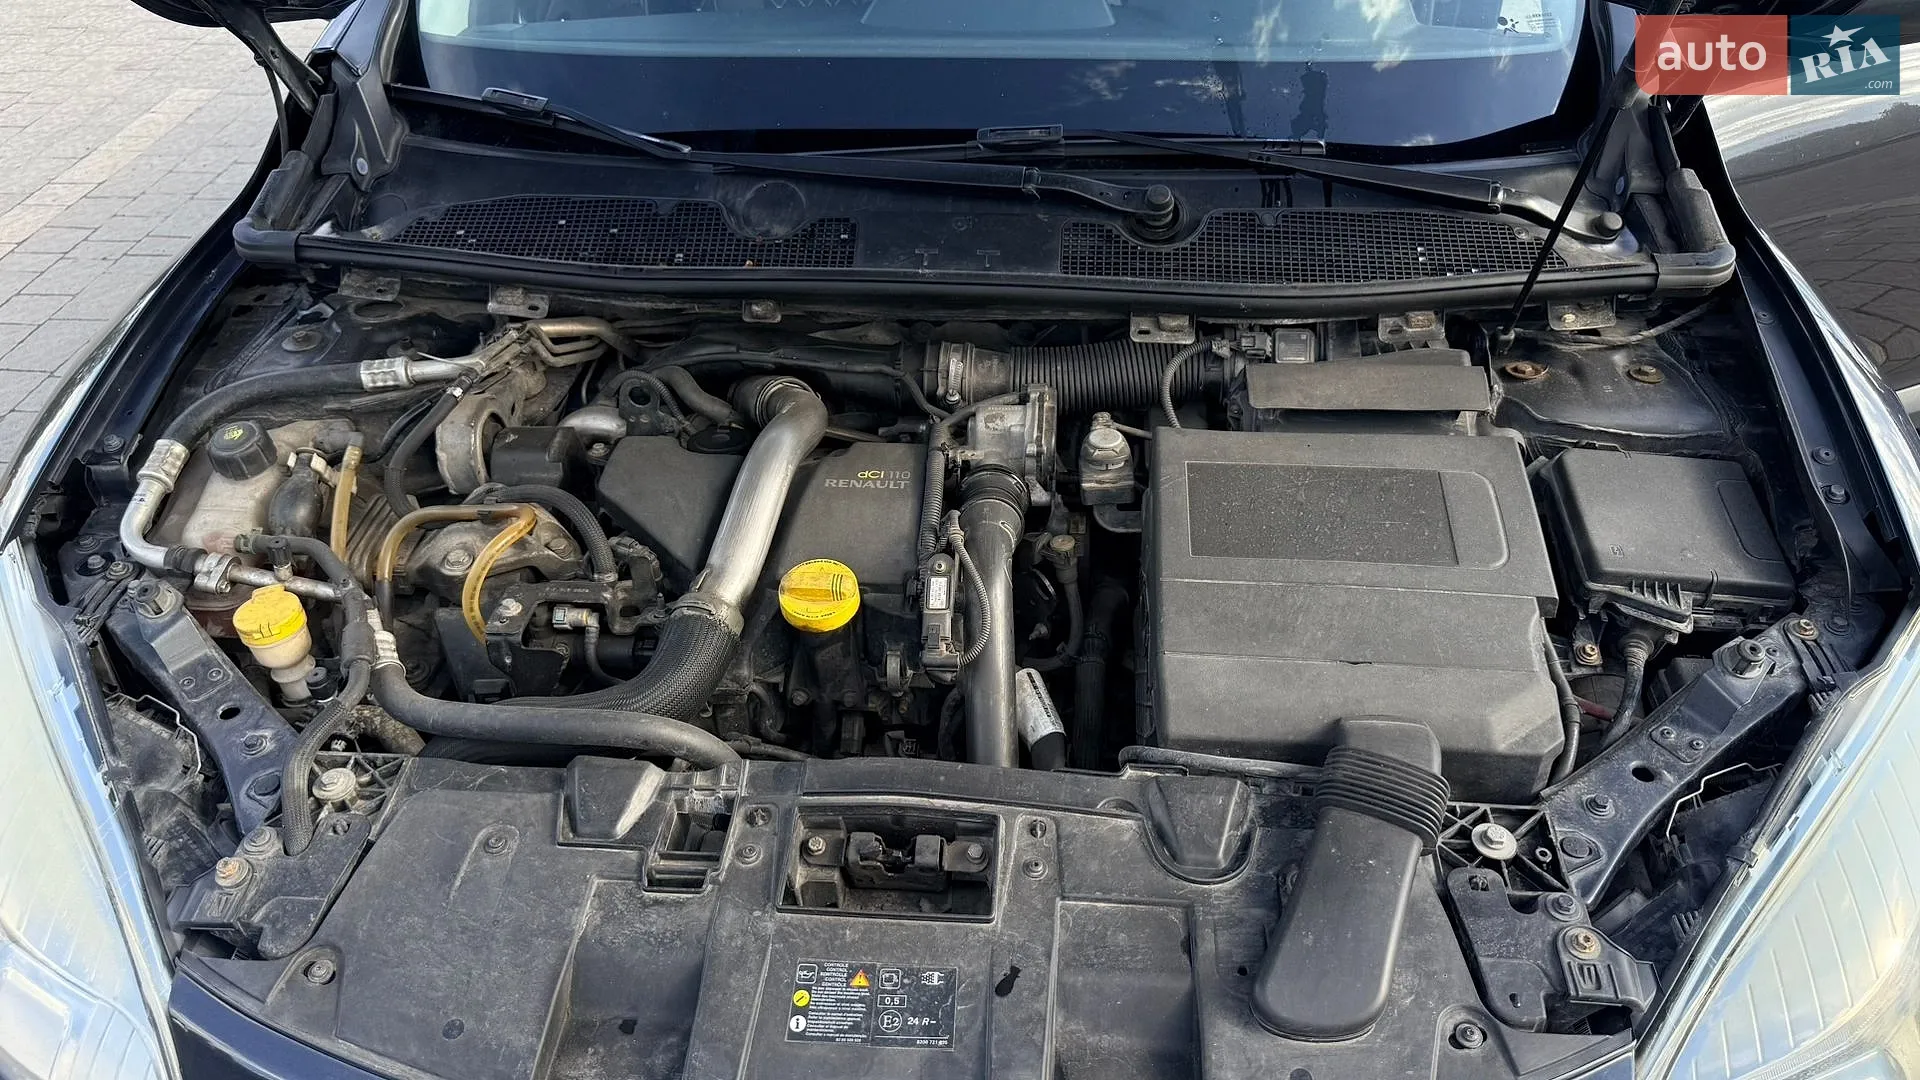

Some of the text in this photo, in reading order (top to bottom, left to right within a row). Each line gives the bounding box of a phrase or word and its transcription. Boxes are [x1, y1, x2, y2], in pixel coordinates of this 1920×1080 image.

[889, 470, 911, 479] 110
[824, 478, 910, 489] RENAULT
[884, 997, 900, 1006] 0,5
[882, 1015, 900, 1028] E2
[907, 1017, 919, 1025] 24
